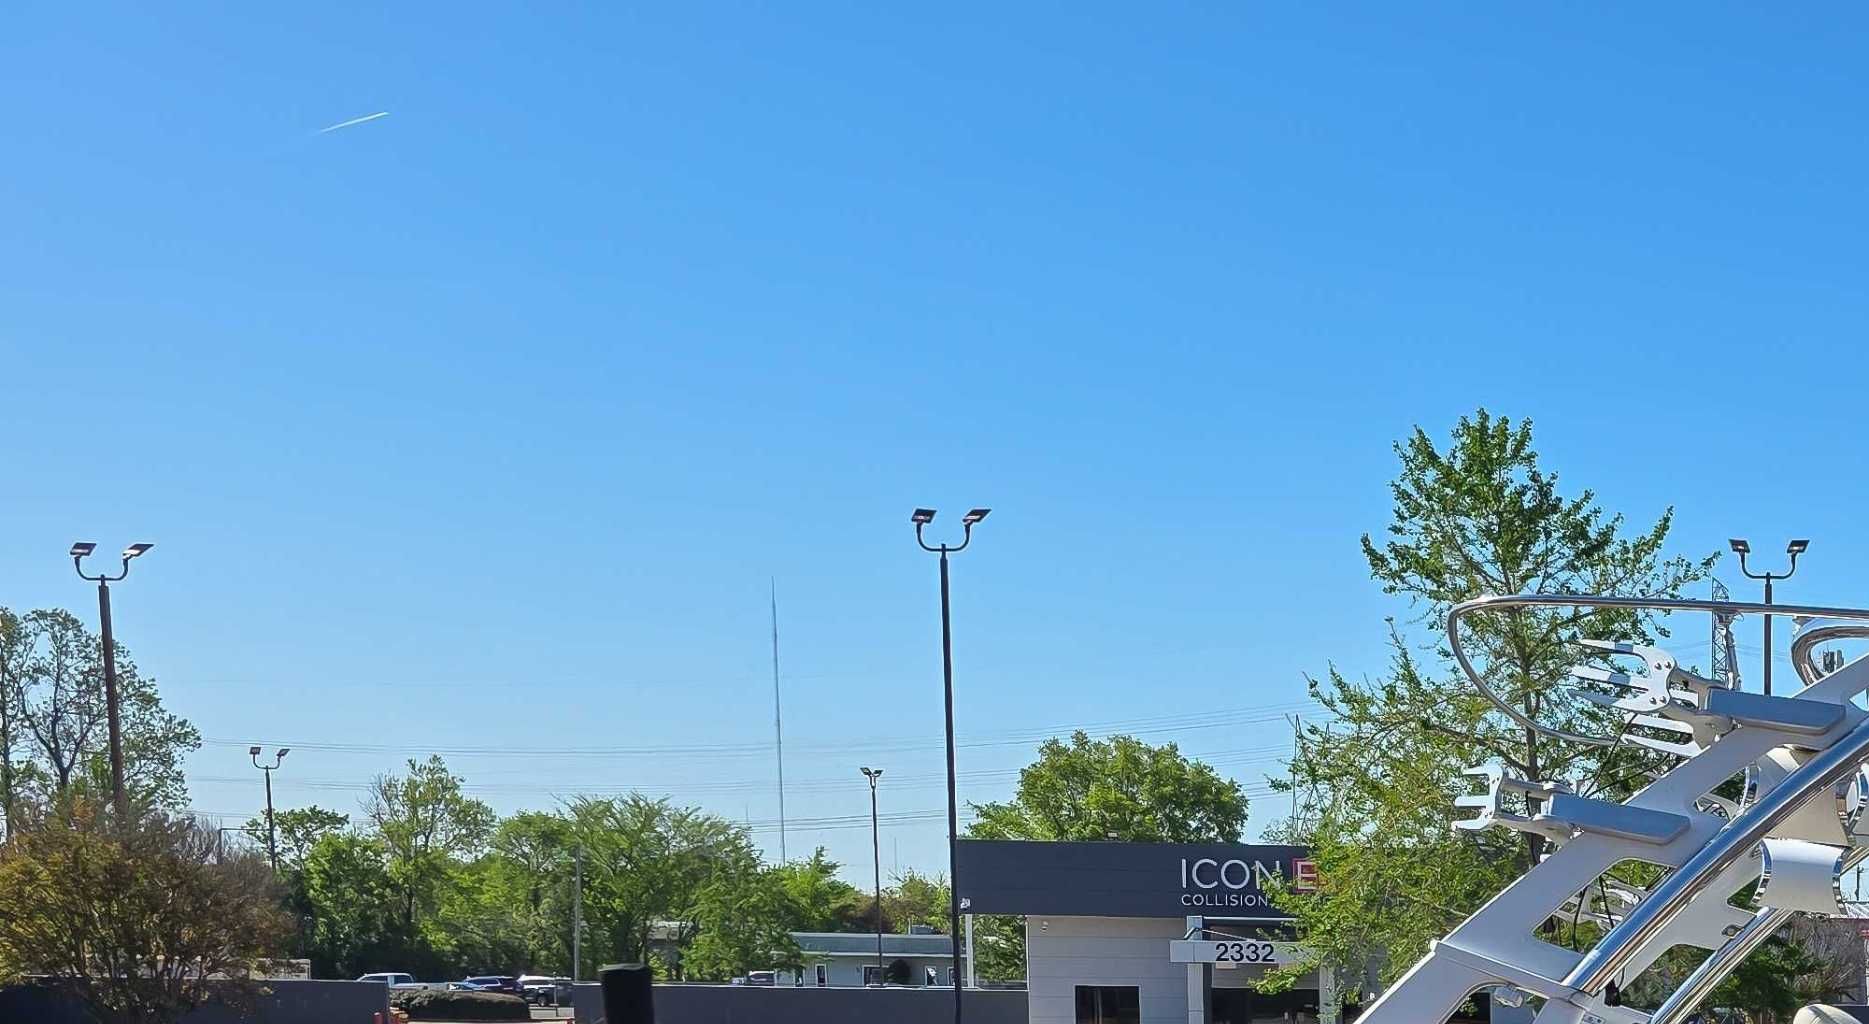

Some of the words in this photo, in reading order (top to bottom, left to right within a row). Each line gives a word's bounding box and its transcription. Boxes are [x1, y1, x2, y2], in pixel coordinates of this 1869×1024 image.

[1181, 858, 1281, 890] ICON
[1181, 894, 1269, 906] COLLISION
[1215, 942, 1275, 963] 2332
